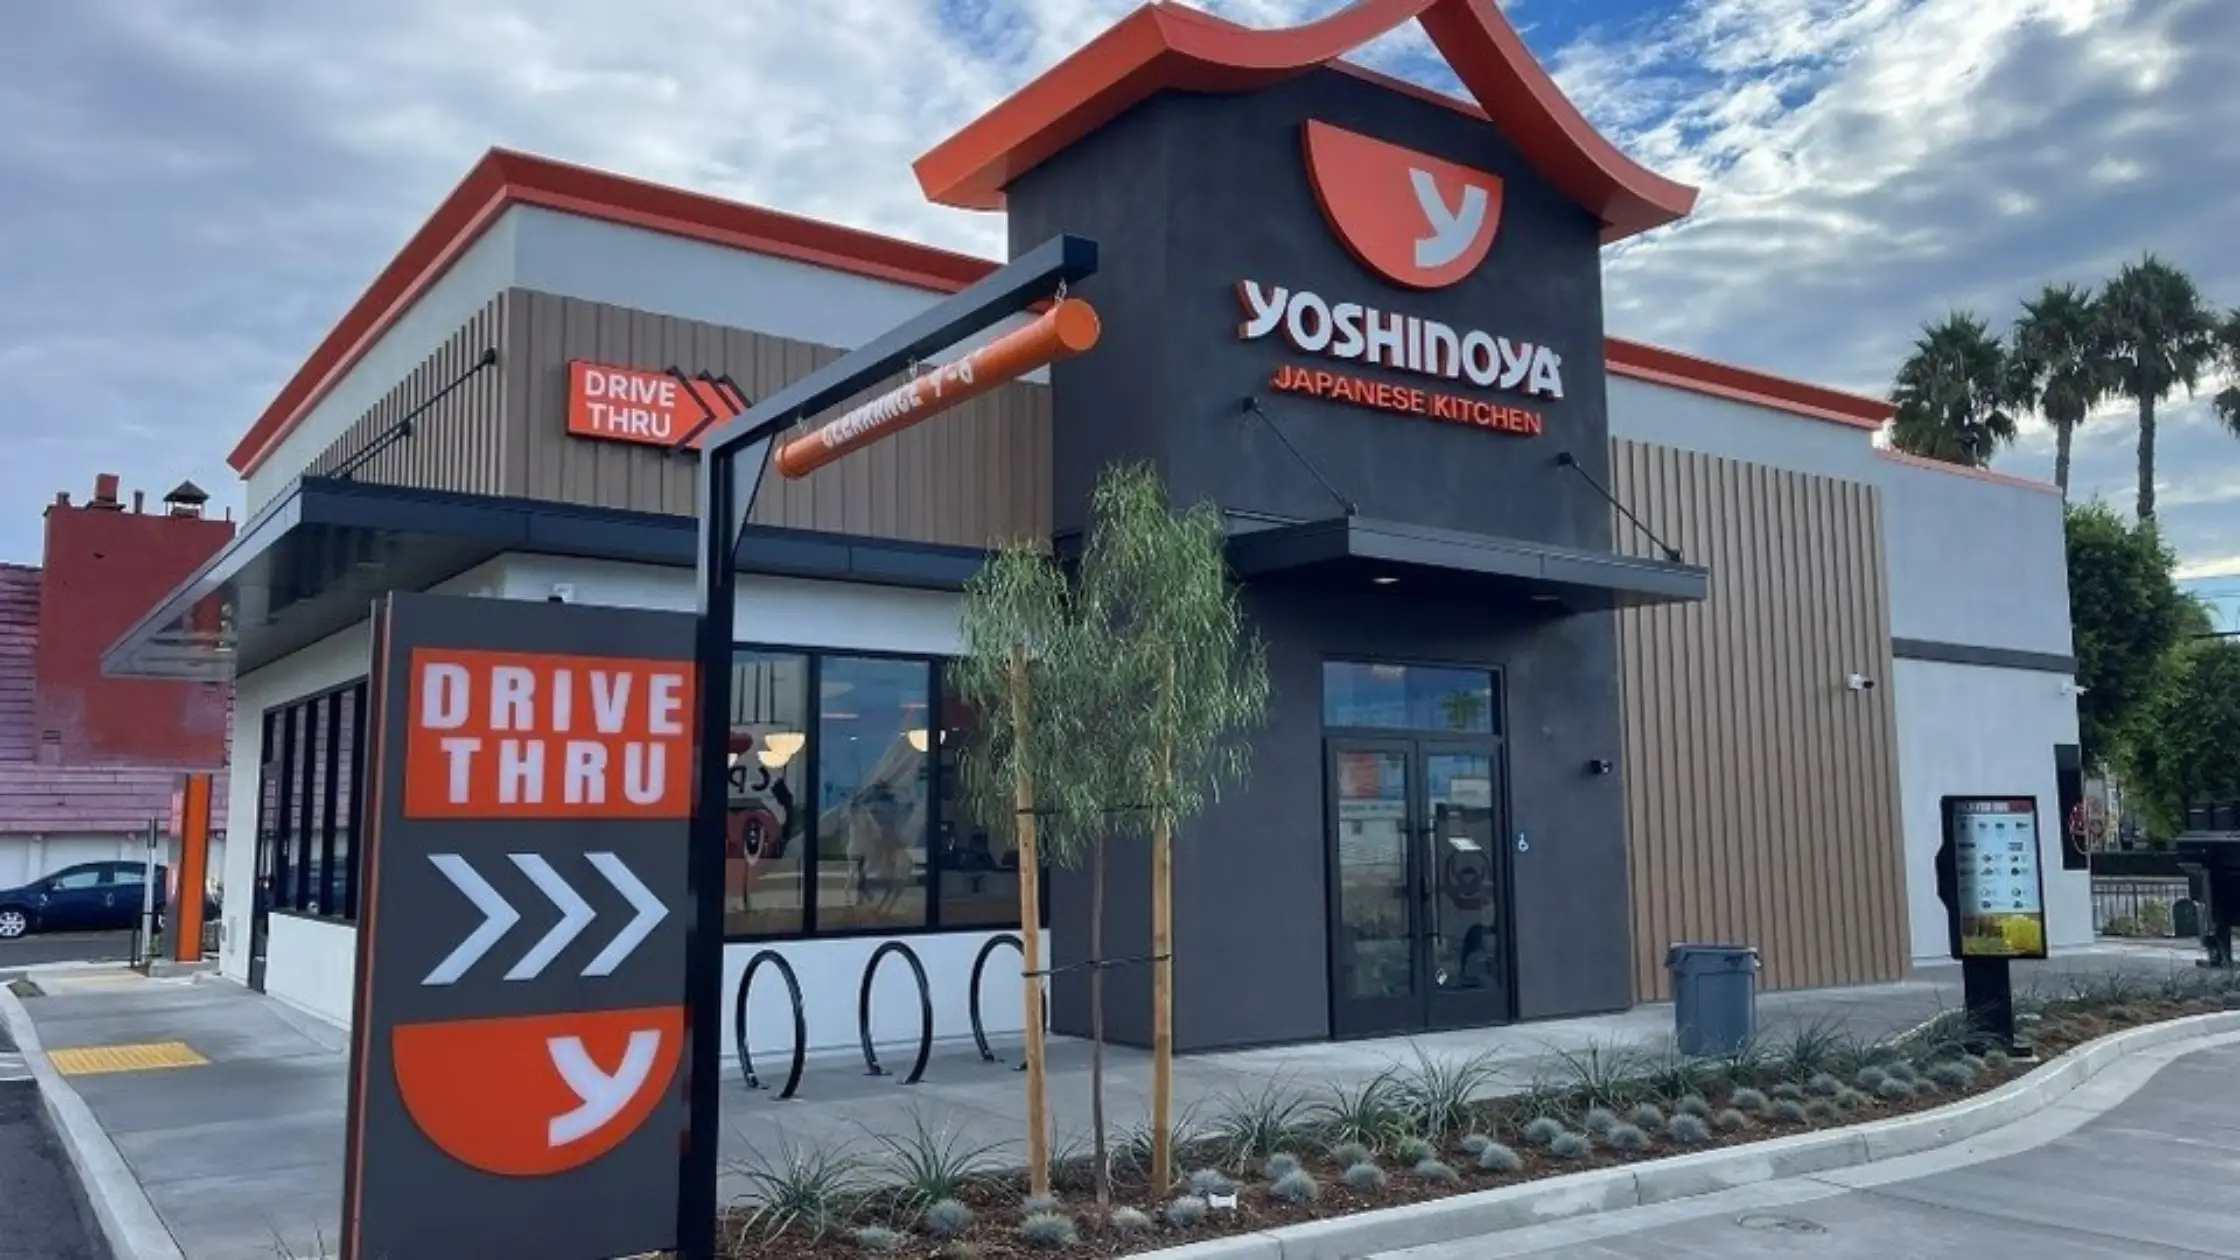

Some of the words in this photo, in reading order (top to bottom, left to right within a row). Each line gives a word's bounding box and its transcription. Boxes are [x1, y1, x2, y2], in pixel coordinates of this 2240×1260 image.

[1238, 280, 1563, 398] YOSHINOYA
[584, 369, 676, 408] DRIVE
[585, 401, 671, 438] THRU
[1273, 364, 1425, 413] JAPANESE
[1430, 392, 1542, 434] KITCHEN
[420, 663, 684, 735] DRIVE
[440, 737, 666, 805] THRU
